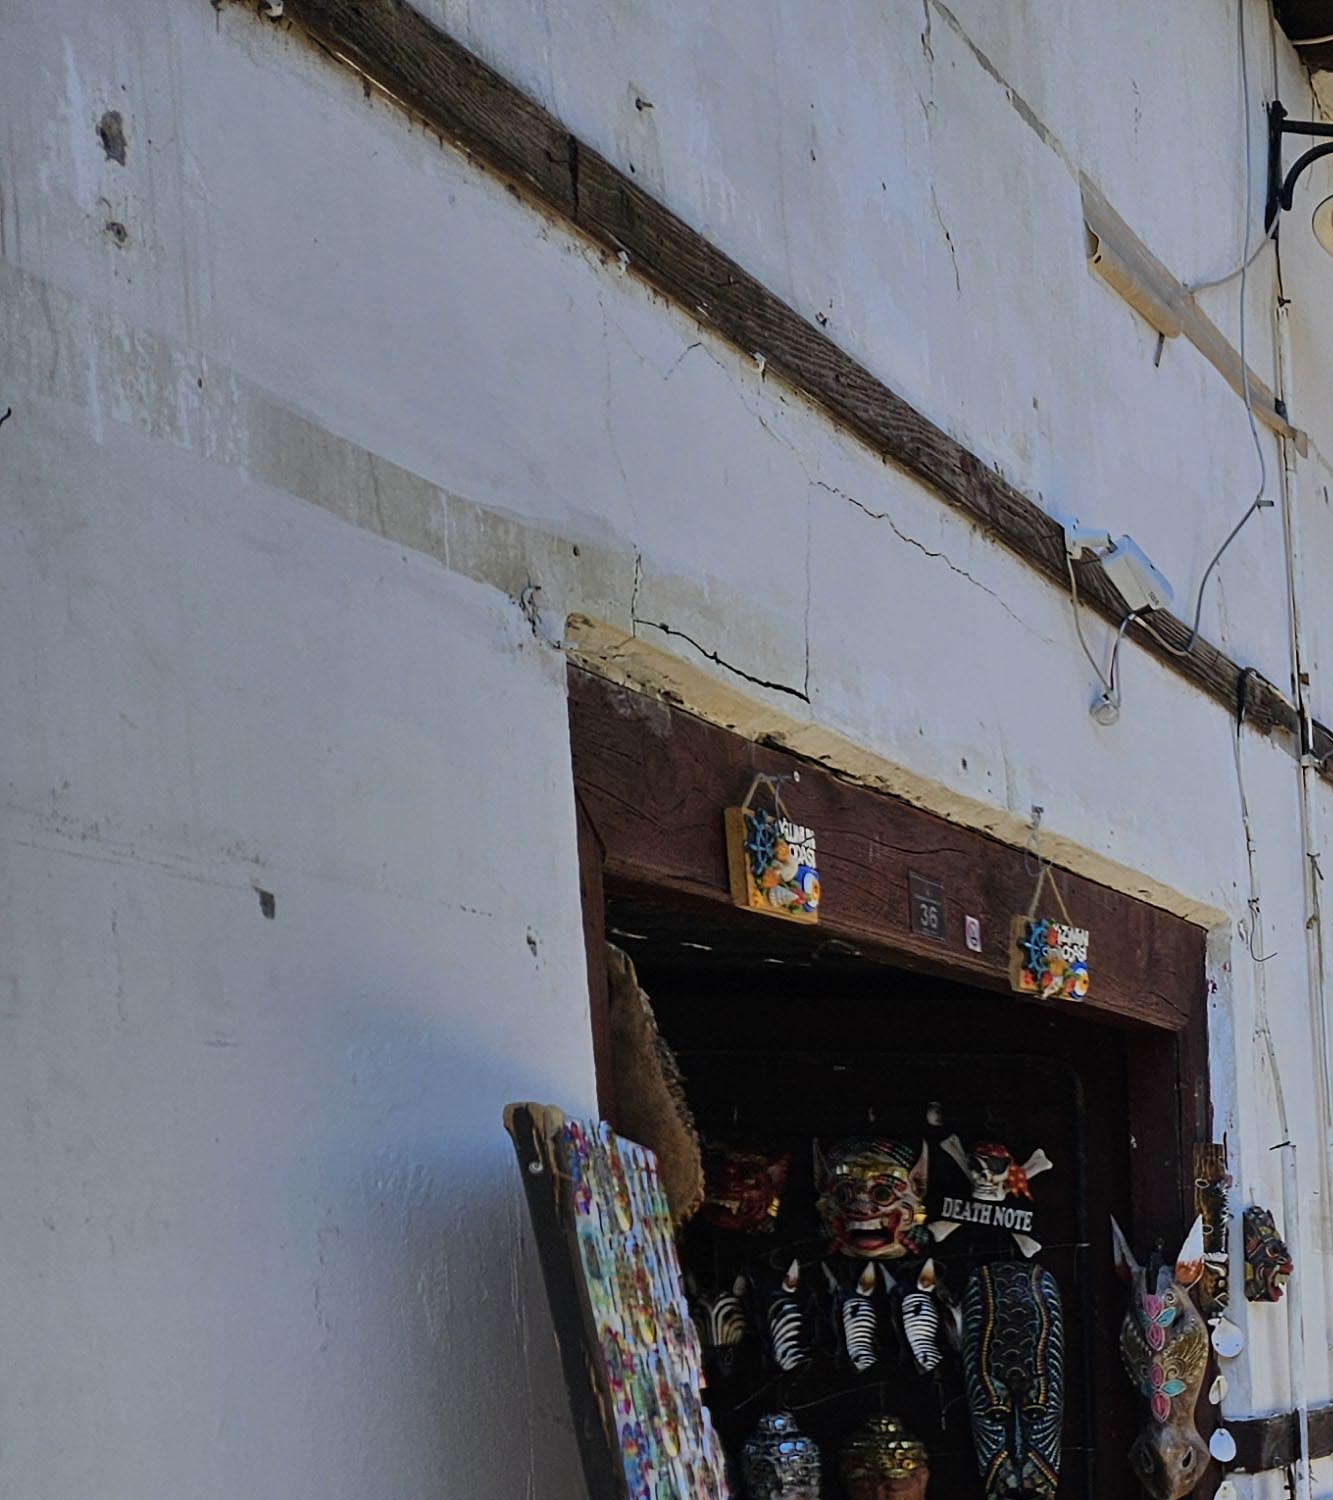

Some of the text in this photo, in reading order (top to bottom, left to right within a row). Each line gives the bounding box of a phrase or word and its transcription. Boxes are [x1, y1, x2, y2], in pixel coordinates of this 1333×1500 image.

[920, 903, 938, 928] 36
[941, 1197, 1033, 1232] DEATH NOTE
